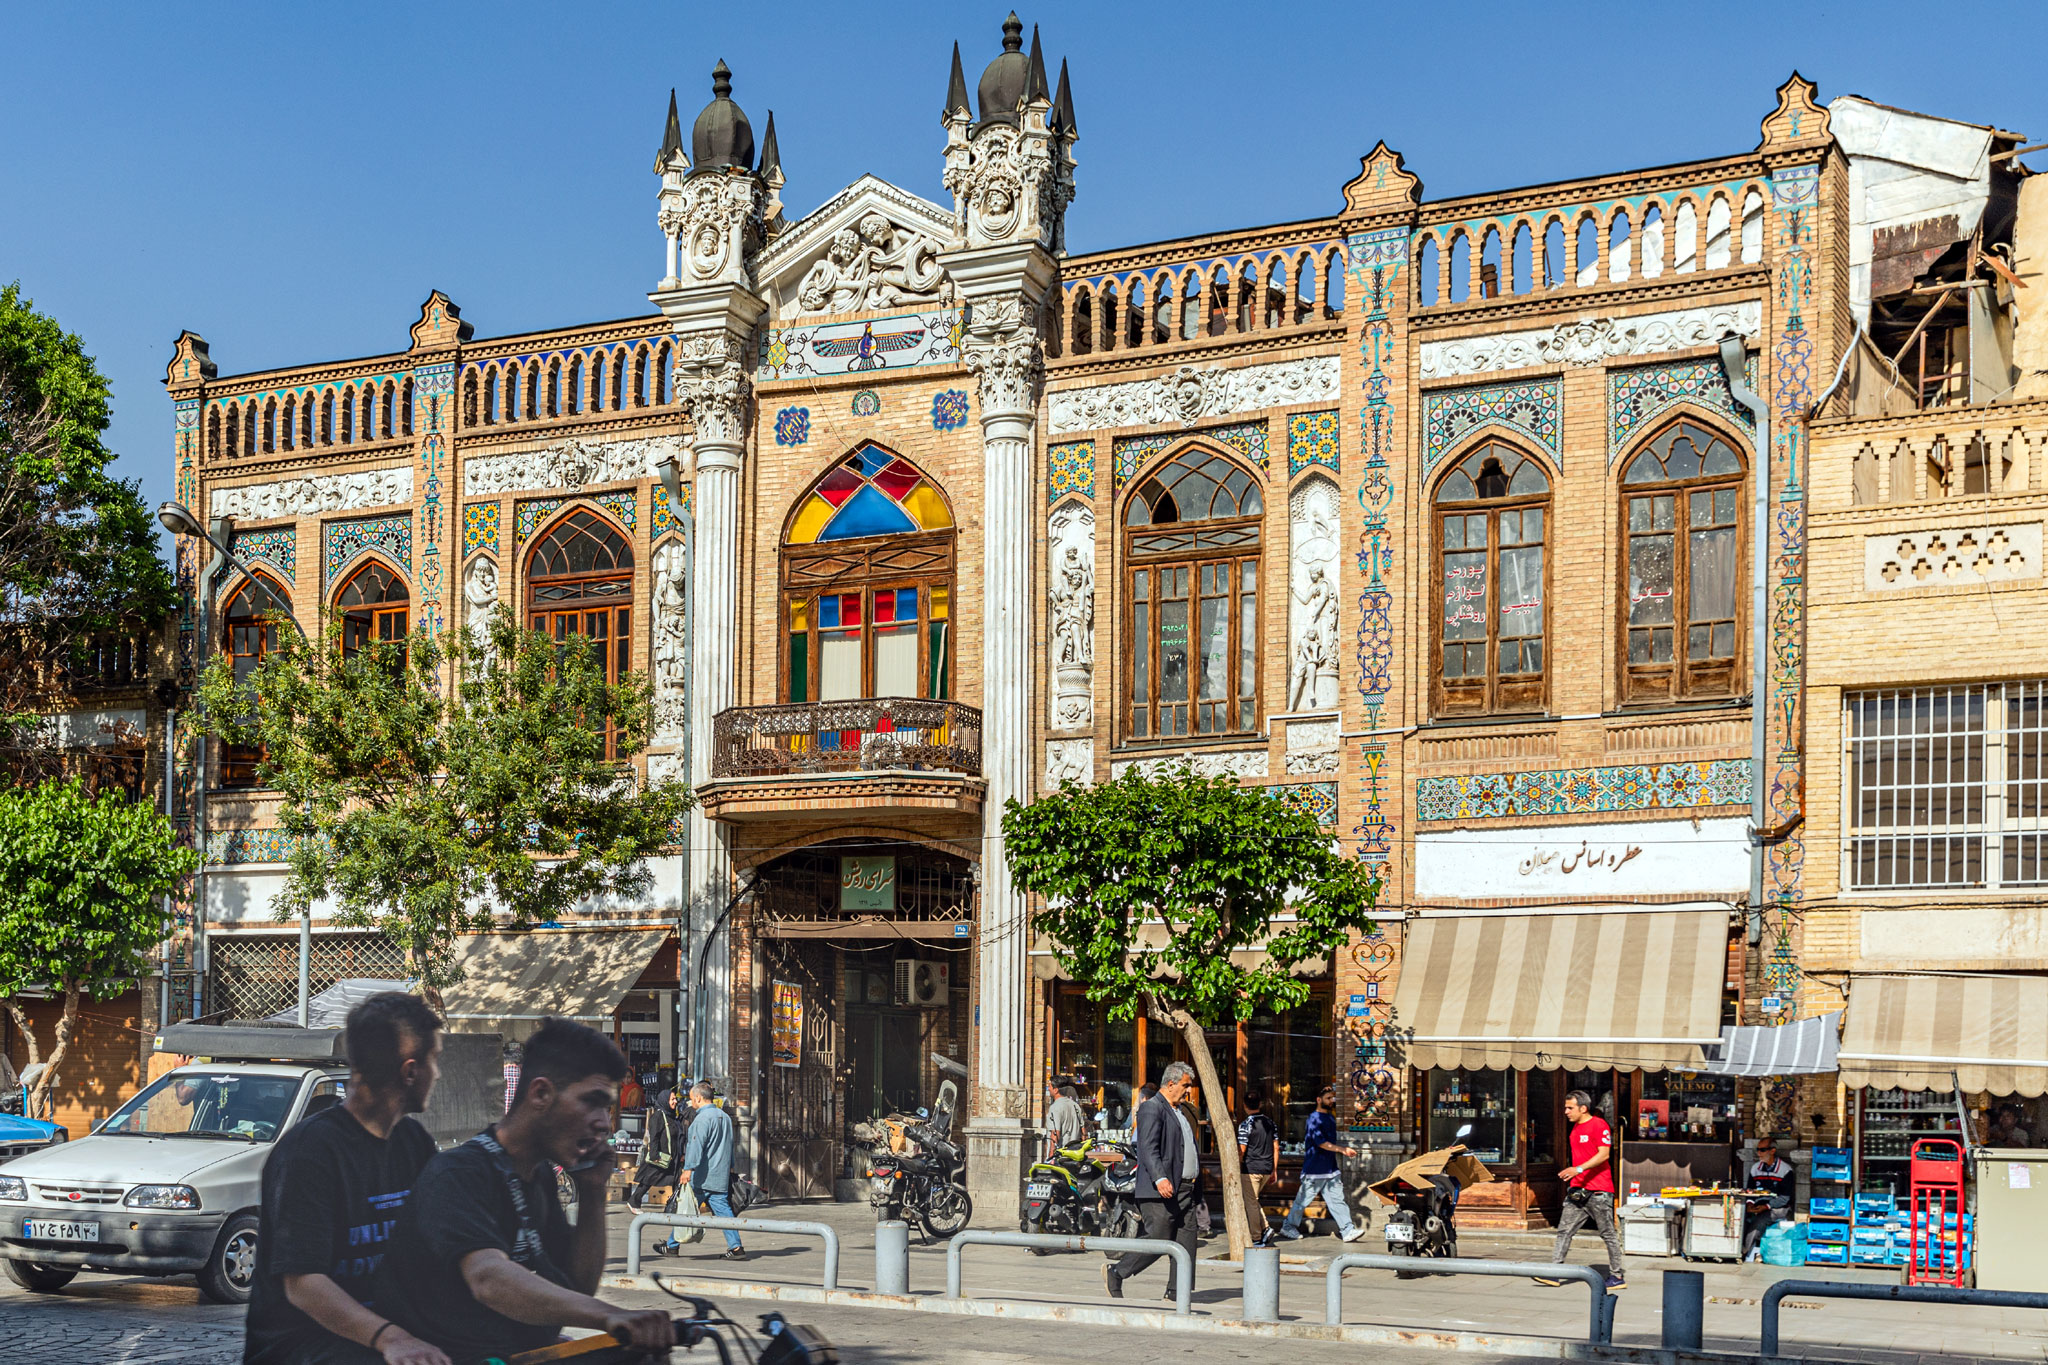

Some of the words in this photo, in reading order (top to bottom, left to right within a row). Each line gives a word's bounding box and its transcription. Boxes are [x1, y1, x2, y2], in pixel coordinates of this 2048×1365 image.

[1447, 564, 1486, 579] بورس
[1446, 584, 1486, 604] لوازم
[1446, 604, 1486, 628] روشنایی
[1561, 840, 1605, 874] اسانس
[1607, 854, 1615, 867] و
[1612, 844, 1642, 872] عطر
[842, 860, 866, 889] روشن
